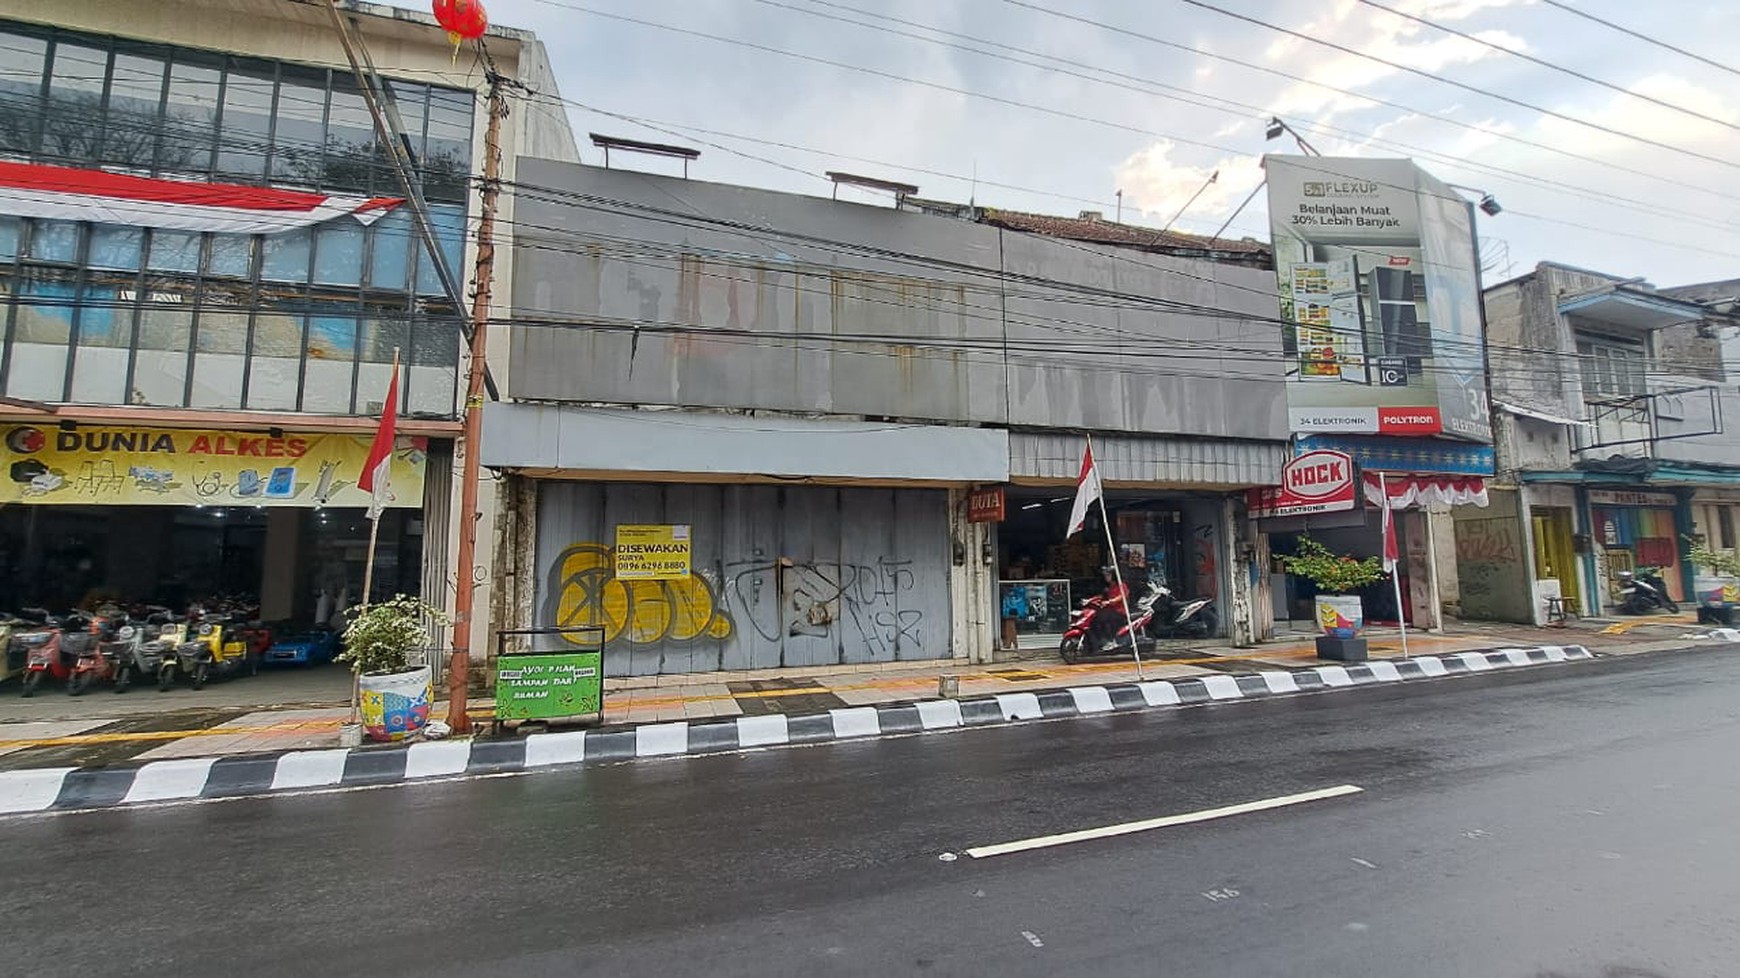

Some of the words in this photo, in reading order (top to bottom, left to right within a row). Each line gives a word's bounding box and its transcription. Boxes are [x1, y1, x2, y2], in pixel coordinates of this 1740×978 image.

[1326, 183, 1378, 194] FLEXUP
[1299, 204, 1358, 216] Belanjaan
[1360, 206, 1391, 216] Muat
[1292, 215, 1318, 225] 30%
[1320, 216, 1353, 226] Lebih
[1356, 217, 1401, 229] Banyak
[1468, 388, 1490, 422] 34
[1313, 417, 1367, 425] ELEKTRONIK
[1384, 416, 1434, 424] POLYTRON
[57, 432, 176, 453] DUNIA
[188, 435, 309, 458] ALKES
[1292, 461, 1342, 487] HOCK
[617, 543, 689, 554] DISEWAKAN
[617, 554, 645, 562] SURYA
[617, 561, 640, 571] 0896
[641, 561, 663, 570] 6296
[664, 560, 686, 569] 8880
